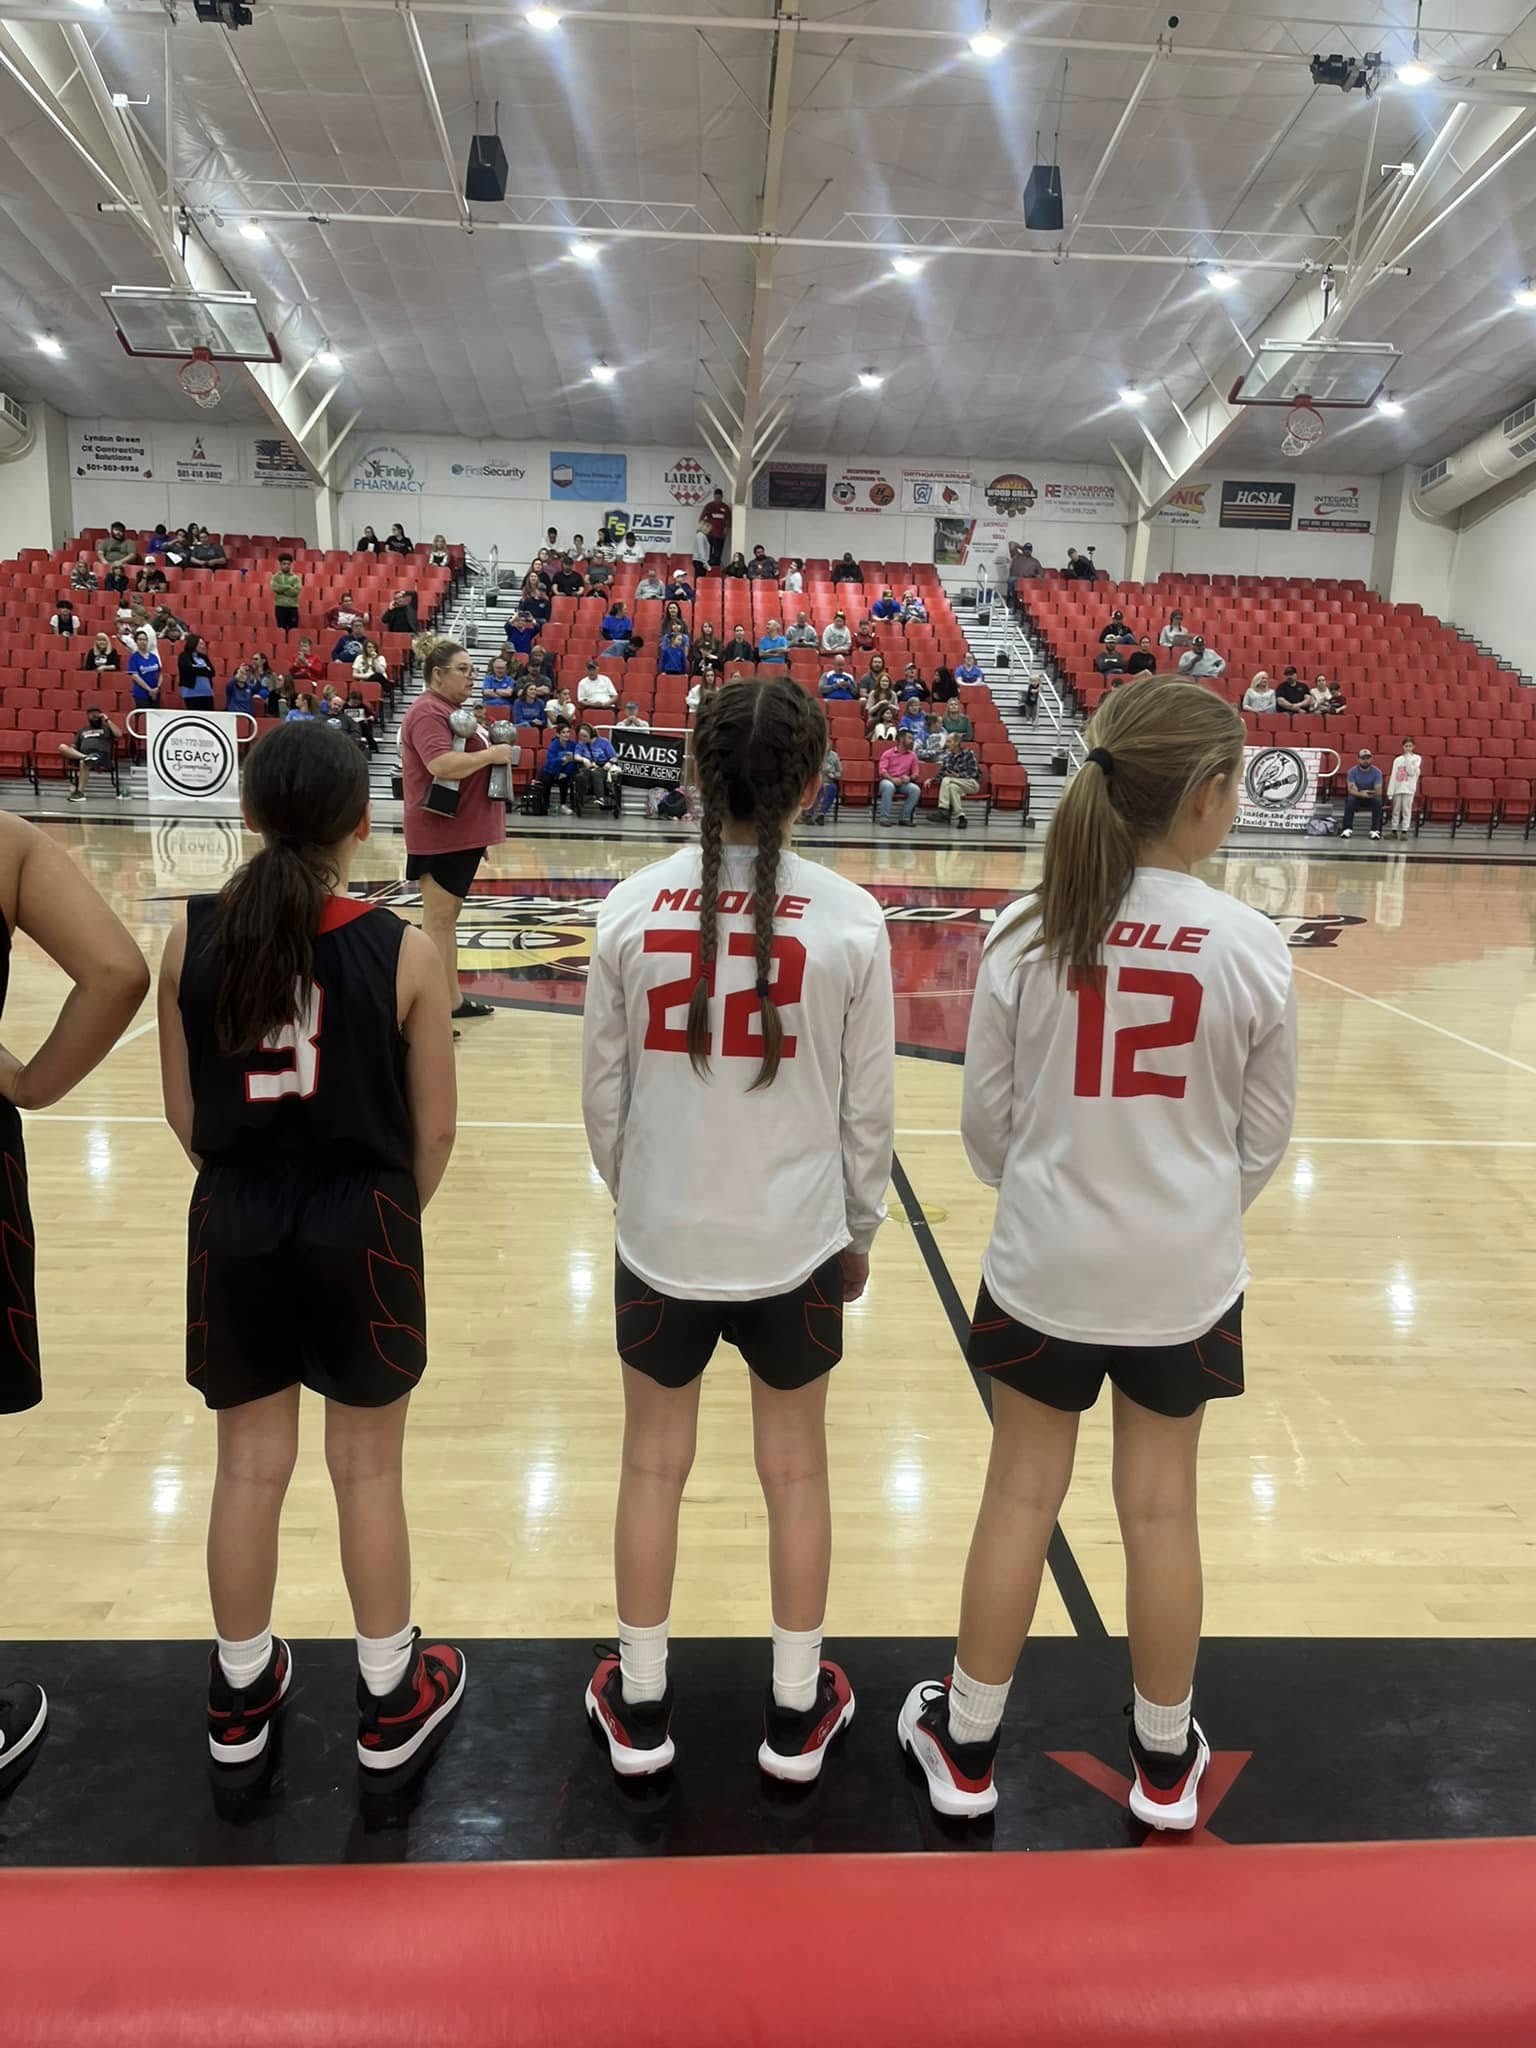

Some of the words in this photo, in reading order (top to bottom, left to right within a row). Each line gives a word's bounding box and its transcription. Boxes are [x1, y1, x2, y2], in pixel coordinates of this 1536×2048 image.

[376, 464, 415, 480] Finley
[664, 472, 712, 485] LARRY'S
[353, 478, 425, 493] PHARMACY
[670, 484, 706, 492] PIZZA
[1063, 485, 1115, 494] RICHARDSON
[1235, 490, 1282, 504] HCSM
[1313, 495, 1361, 503] INTEGRITY
[631, 513, 675, 529] FAST
[633, 534, 672, 544] OLUTIONS
[165, 749, 220, 763] LEGACY
[616, 742, 679, 765] JAMES
[619, 762, 650, 776] URANCE
[651, 767, 681, 780] AGENCY
[1268, 819, 1283, 828] The
[1104, 920, 1211, 954] OLE
[642, 928, 808, 1059] 22
[1066, 965, 1204, 1099] 12
